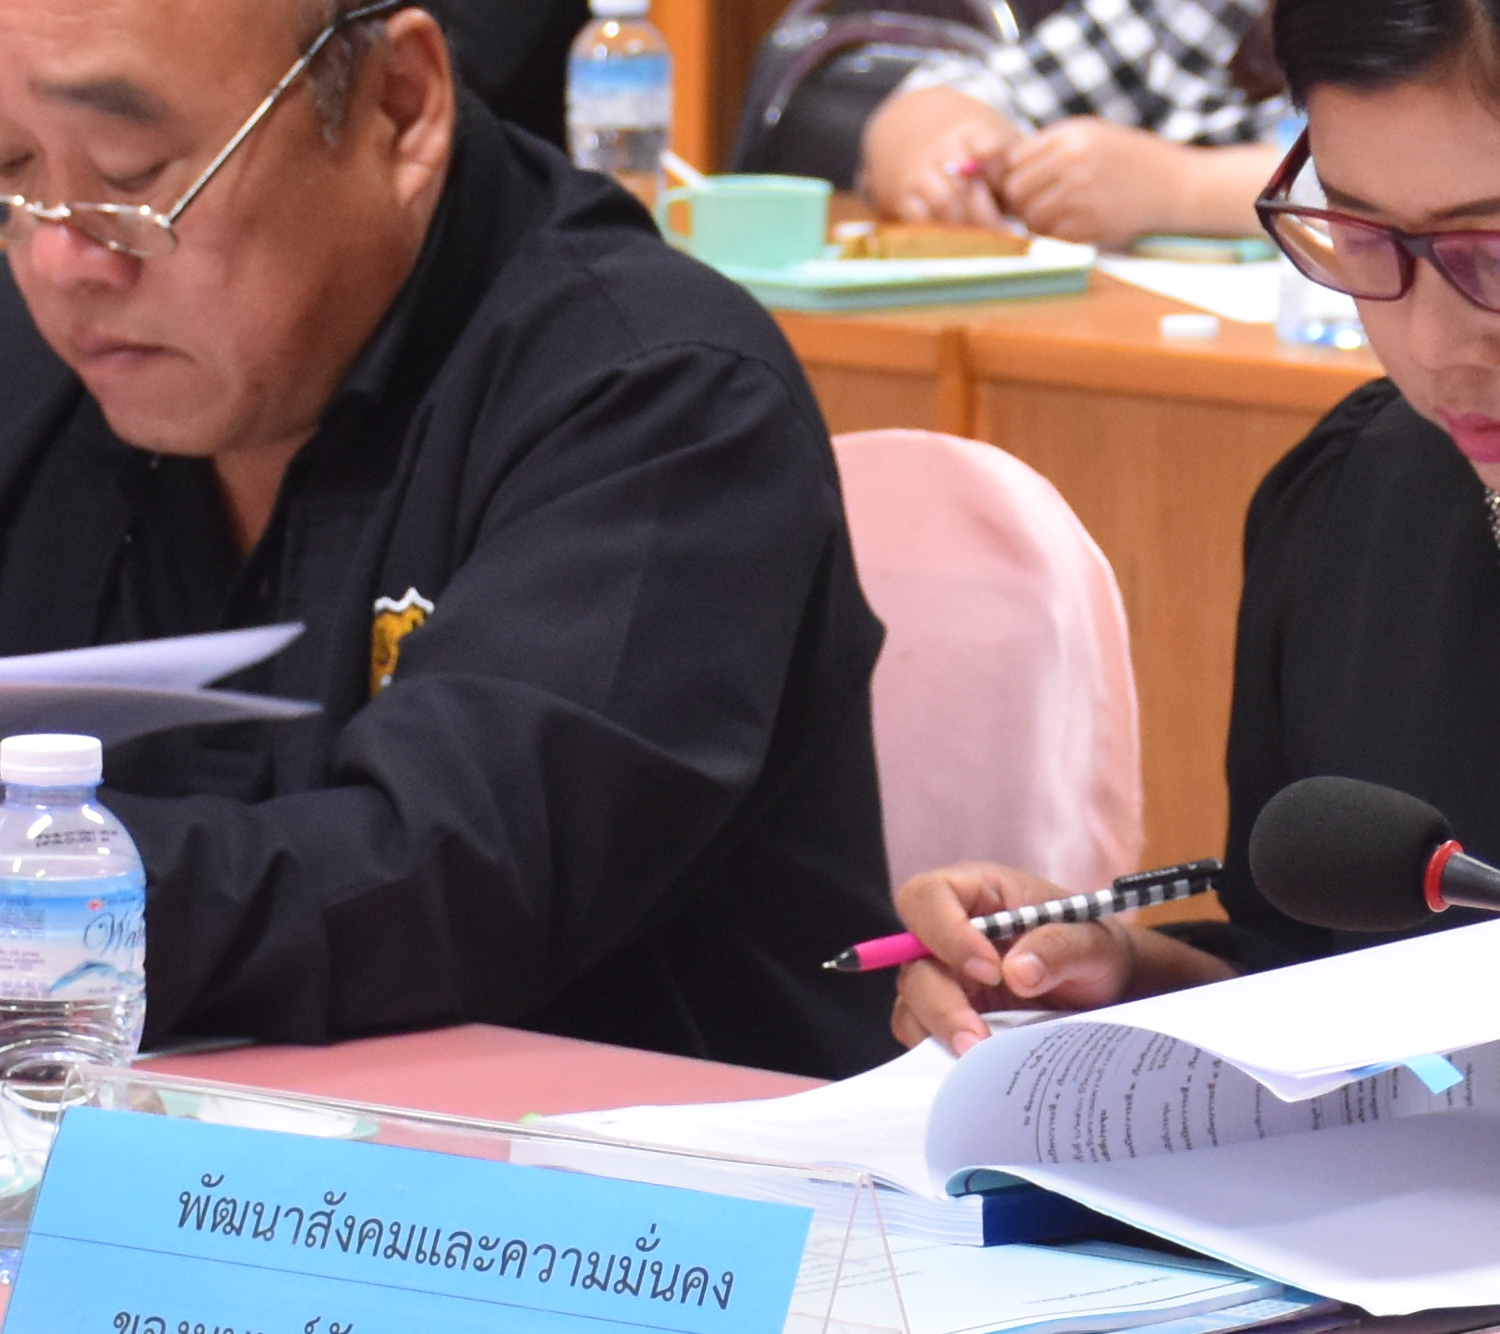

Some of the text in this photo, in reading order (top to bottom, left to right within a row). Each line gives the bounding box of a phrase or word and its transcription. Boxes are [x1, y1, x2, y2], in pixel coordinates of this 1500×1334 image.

[177, 1172, 735, 1310] พัฒนาสังคมและความมั่นคง
